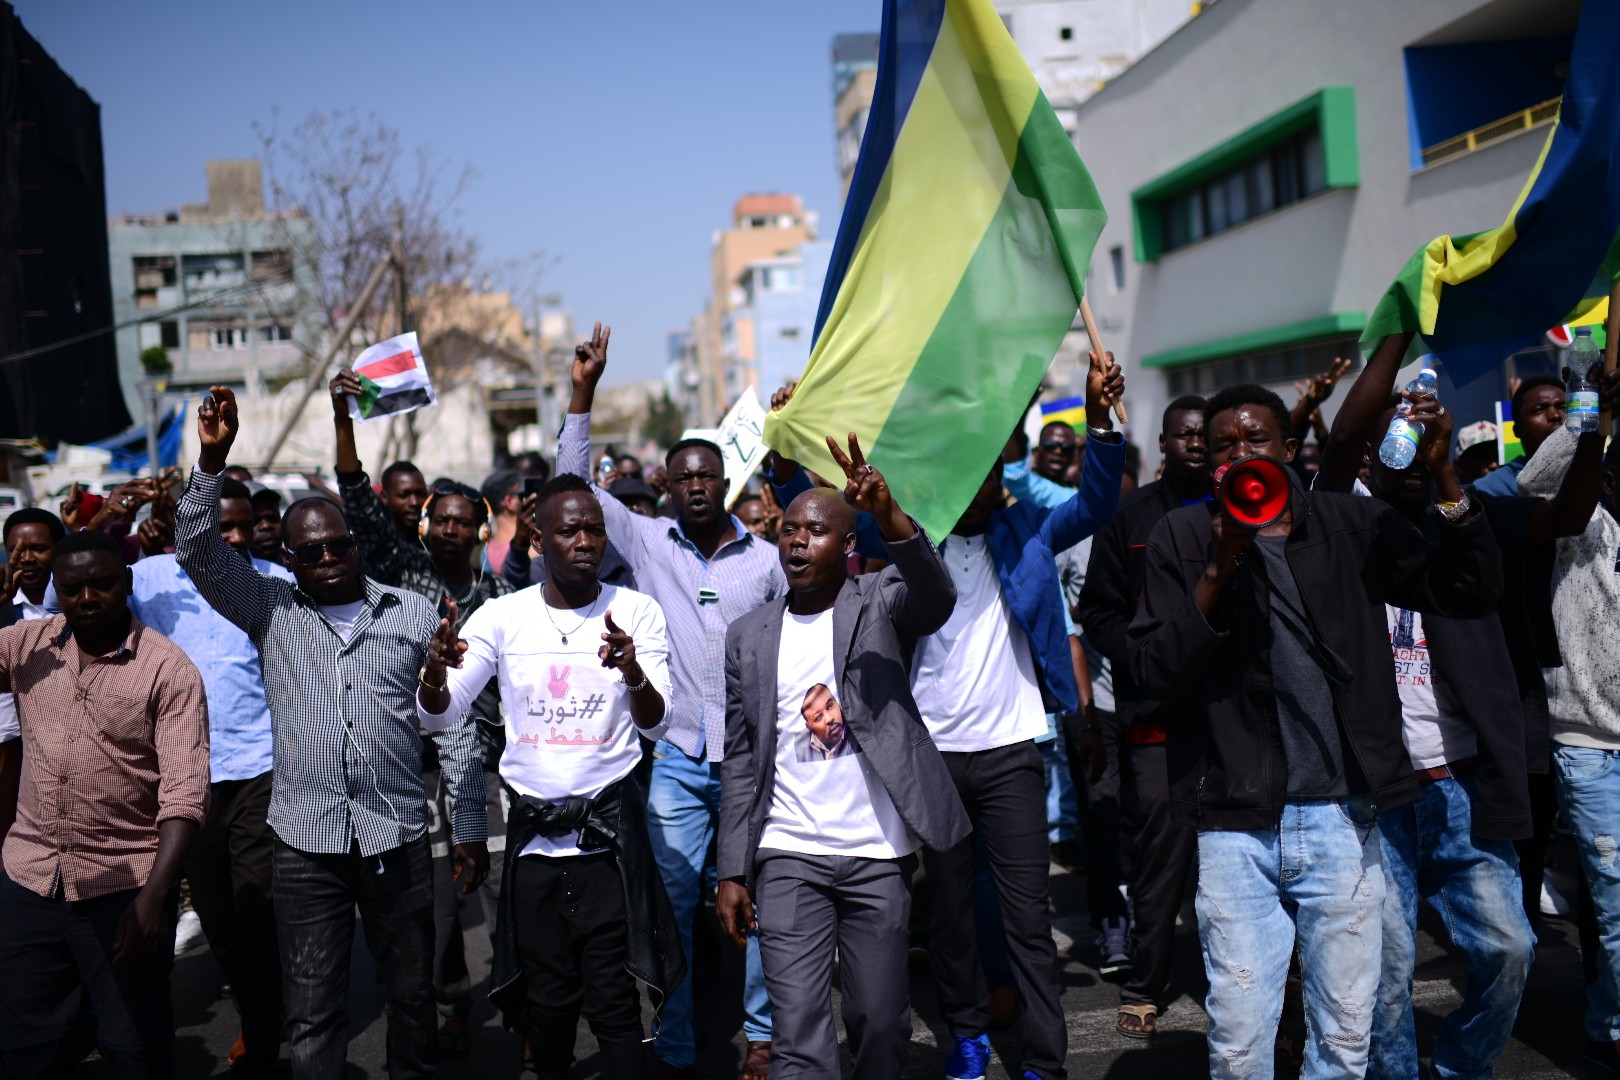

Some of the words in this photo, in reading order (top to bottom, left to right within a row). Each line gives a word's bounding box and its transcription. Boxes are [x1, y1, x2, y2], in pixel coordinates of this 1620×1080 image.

[1393, 648, 1427, 661] ACHT
[1411, 676, 1427, 686] IN
[526, 693, 607, 725] #ثورتنا
